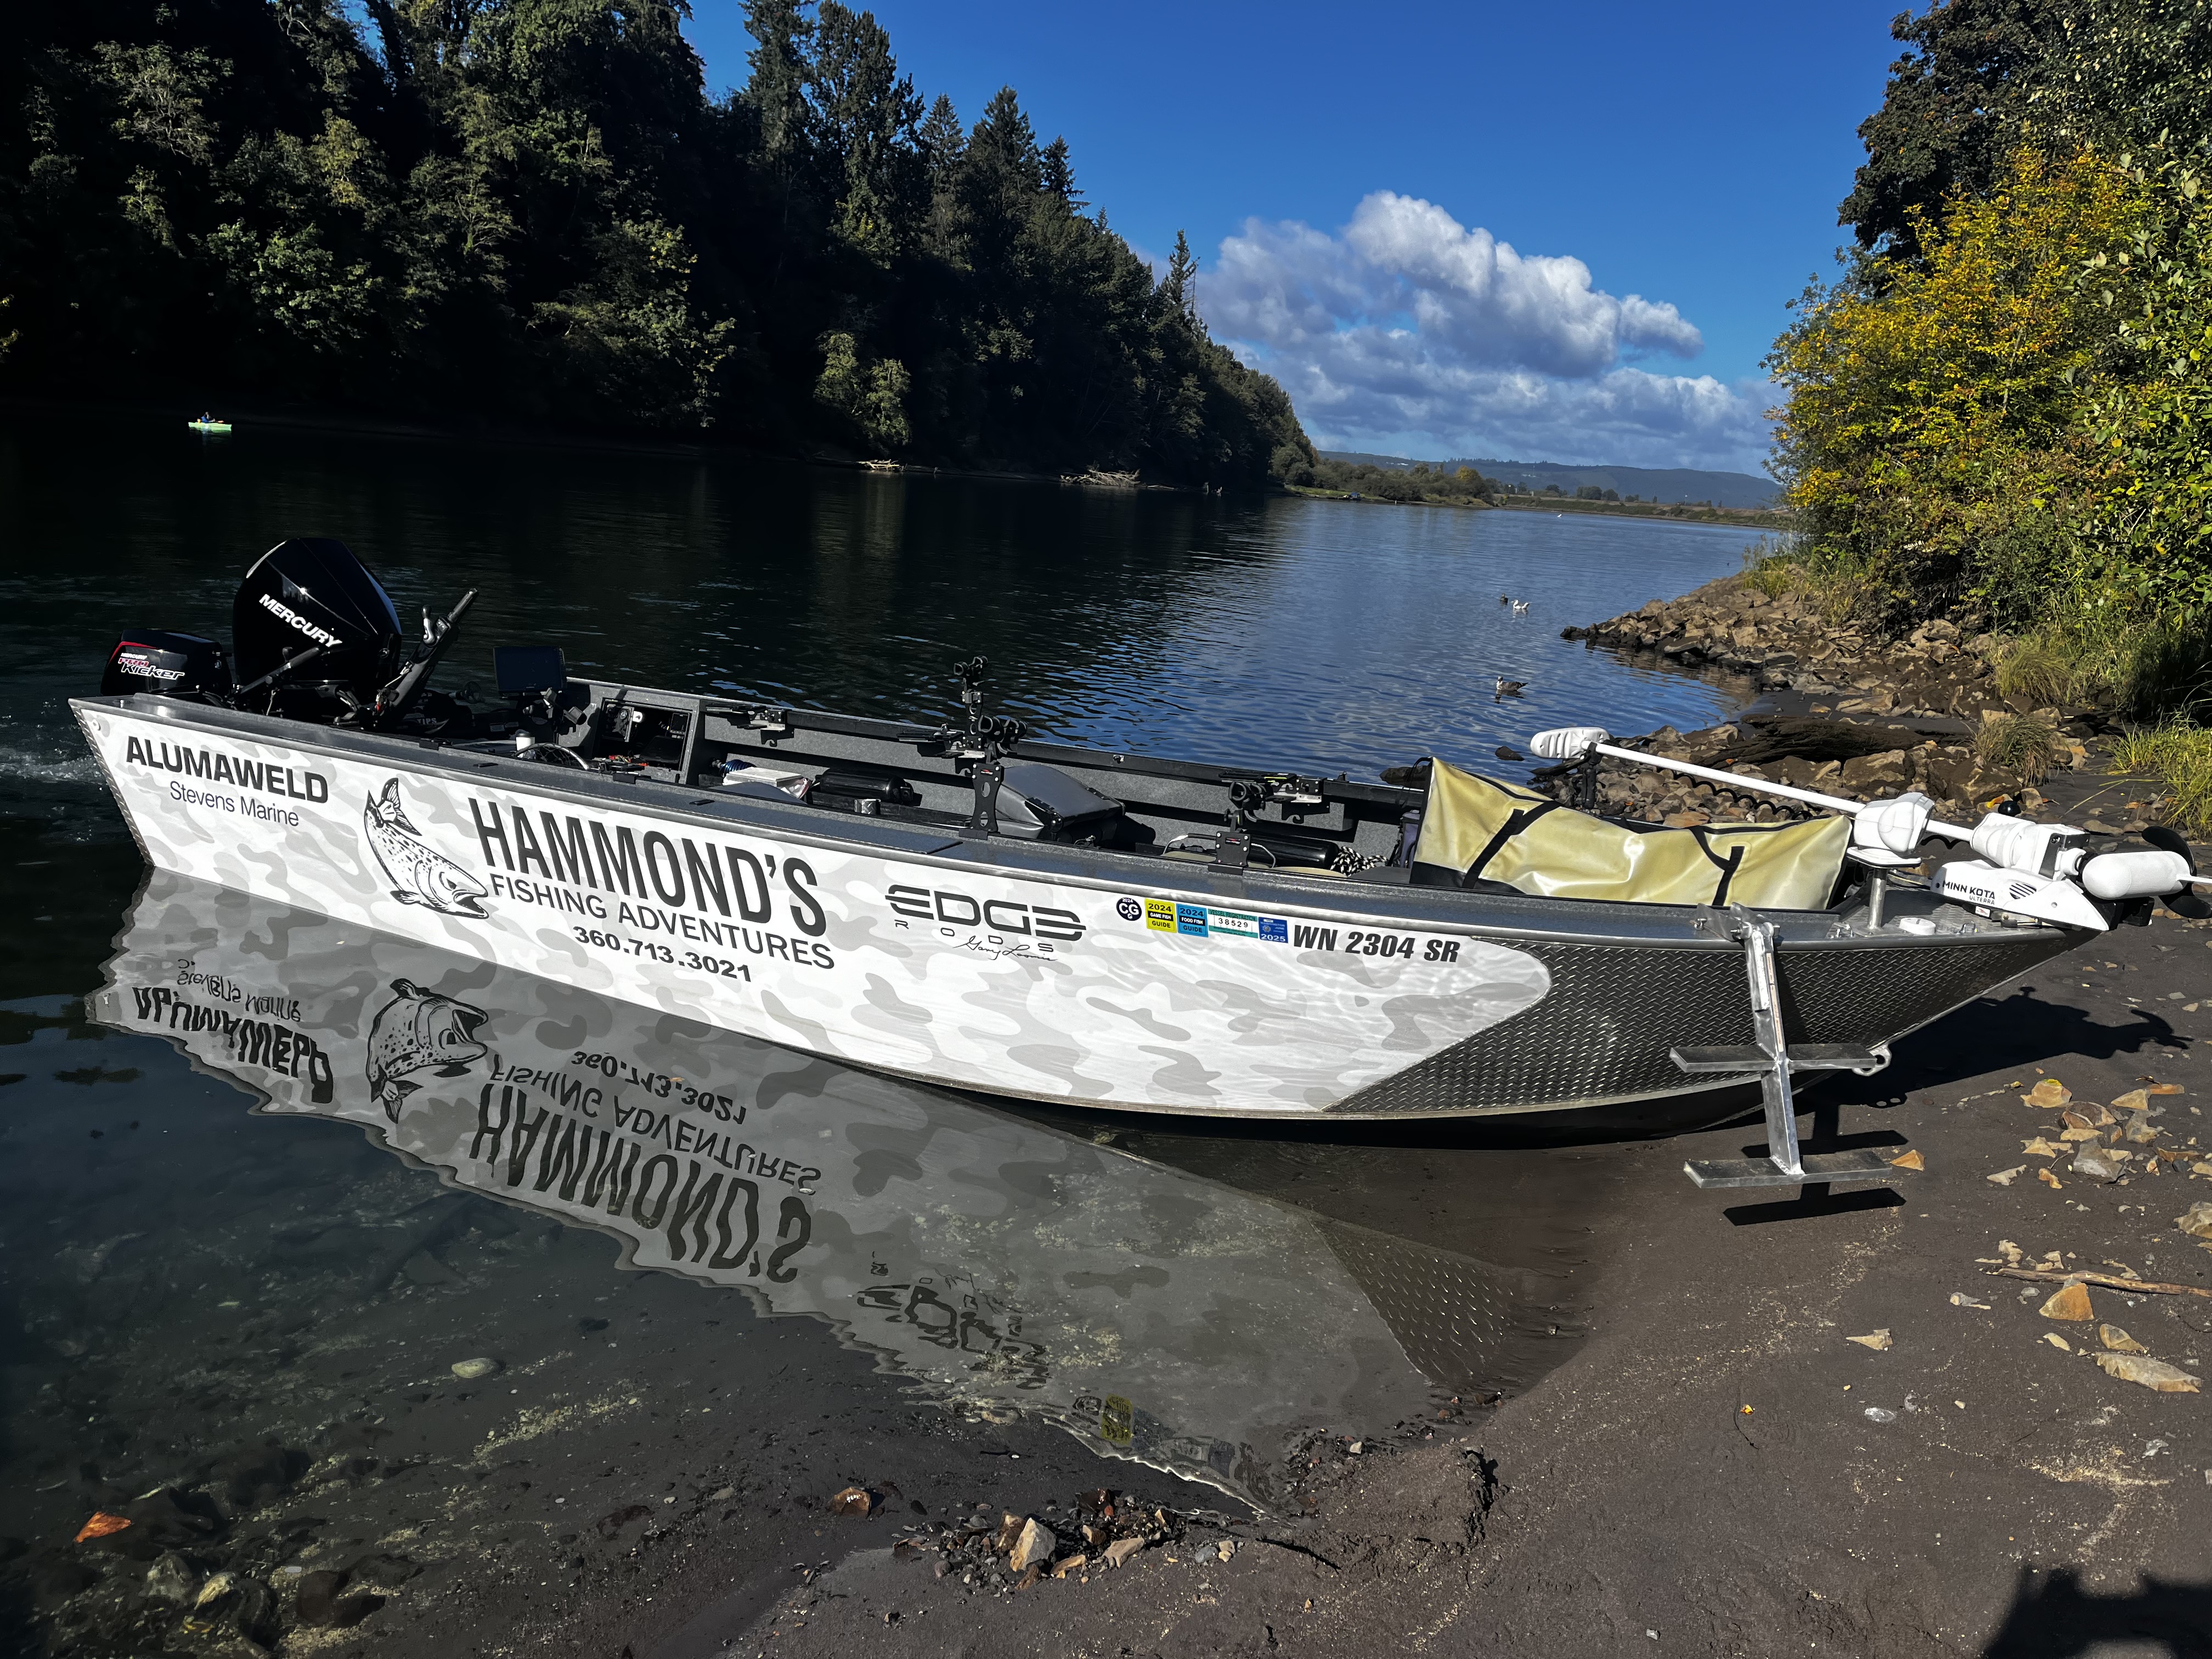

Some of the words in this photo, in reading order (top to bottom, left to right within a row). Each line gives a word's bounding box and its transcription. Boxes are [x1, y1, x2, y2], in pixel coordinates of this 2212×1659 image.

[259, 594, 343, 648] MERCURY
[117, 657, 149, 667] PRO
[126, 735, 329, 804] ALUMAWELD
[170, 780, 235, 812] Stevens
[240, 795, 299, 827] Marine
[467, 797, 827, 937] HAMMOND'S
[1942, 880, 1968, 893] MINN
[1969, 886, 1995, 900] KOTA
[1148, 902, 1172, 912] 2024
[1969, 895, 1995, 906] ULTERRA
[1119, 902, 1139, 916] CG
[1180, 907, 1204, 917] 2024
[1209, 909, 1226, 917] VESSEL
[1226, 912, 1257, 922] REGISTRATION
[489, 872, 607, 920] FISHING
[618, 901, 835, 970] ADVENTURES
[1152, 920, 1171, 928] GUIDE
[1218, 917, 1249, 928] 38529
[1183, 924, 1203, 933] GUIDE
[1261, 933, 1286, 943] 2025
[1294, 924, 1338, 951] WN
[1345, 931, 1415, 959] 2304
[1424, 939, 1460, 963] SR
[573, 925, 752, 983] 360.713.3021
